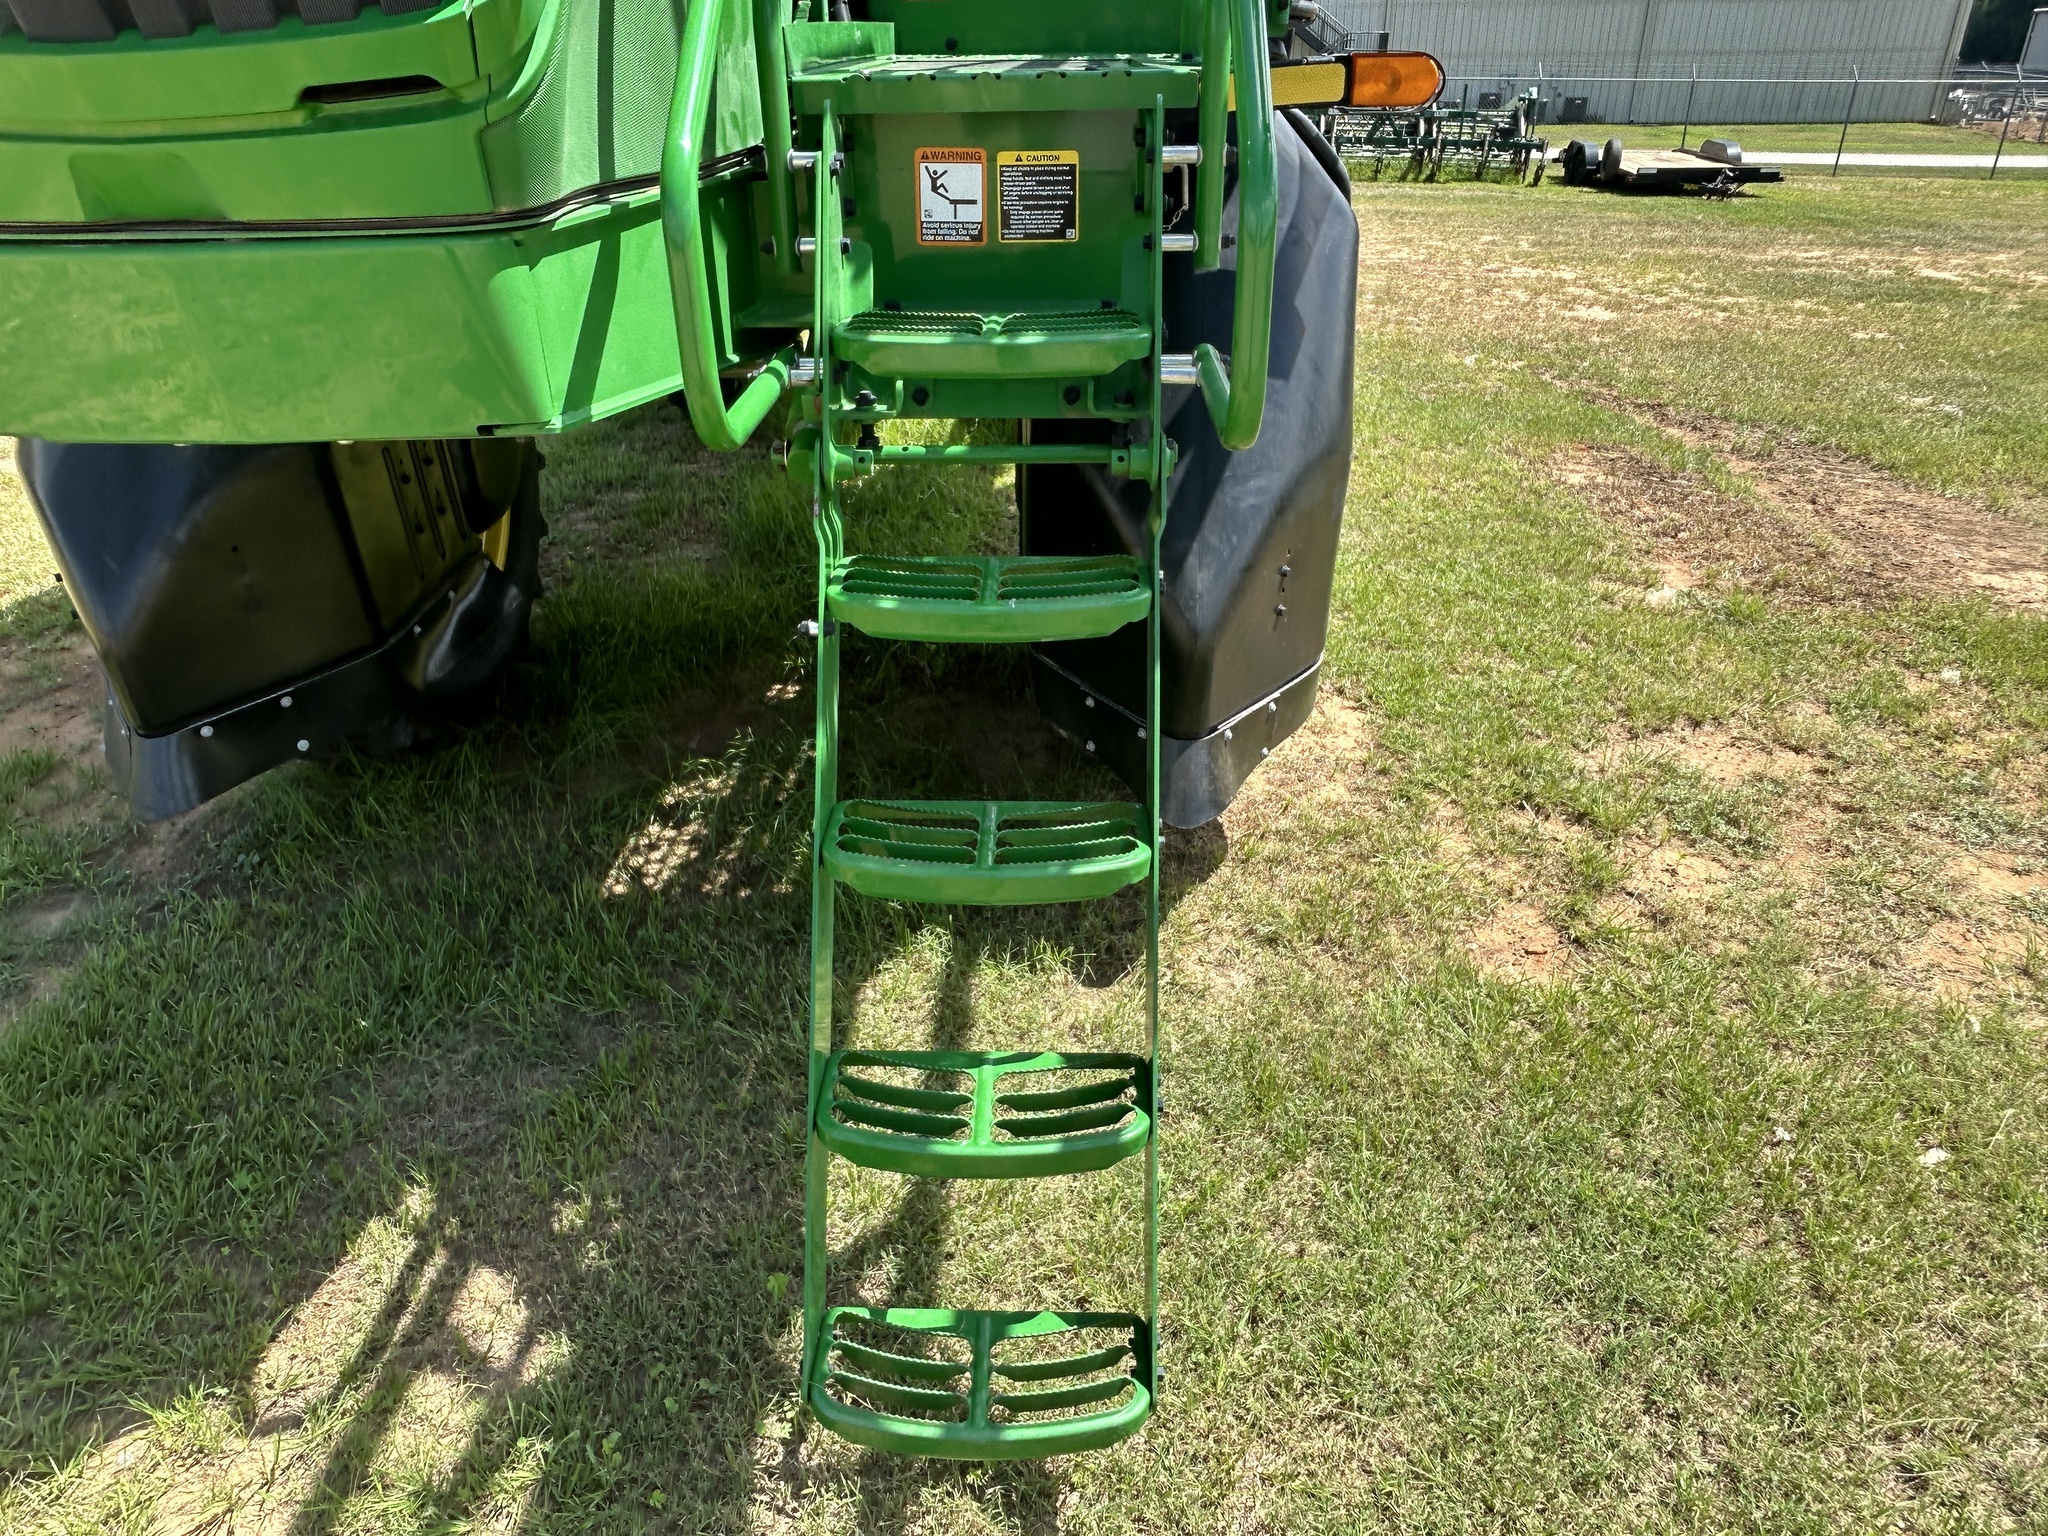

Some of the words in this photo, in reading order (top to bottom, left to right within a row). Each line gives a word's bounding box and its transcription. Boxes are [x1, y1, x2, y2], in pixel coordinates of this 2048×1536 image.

[931, 151, 981, 161] WARNING
[1026, 154, 1060, 162] CAUTION
[963, 222, 981, 230] injury
